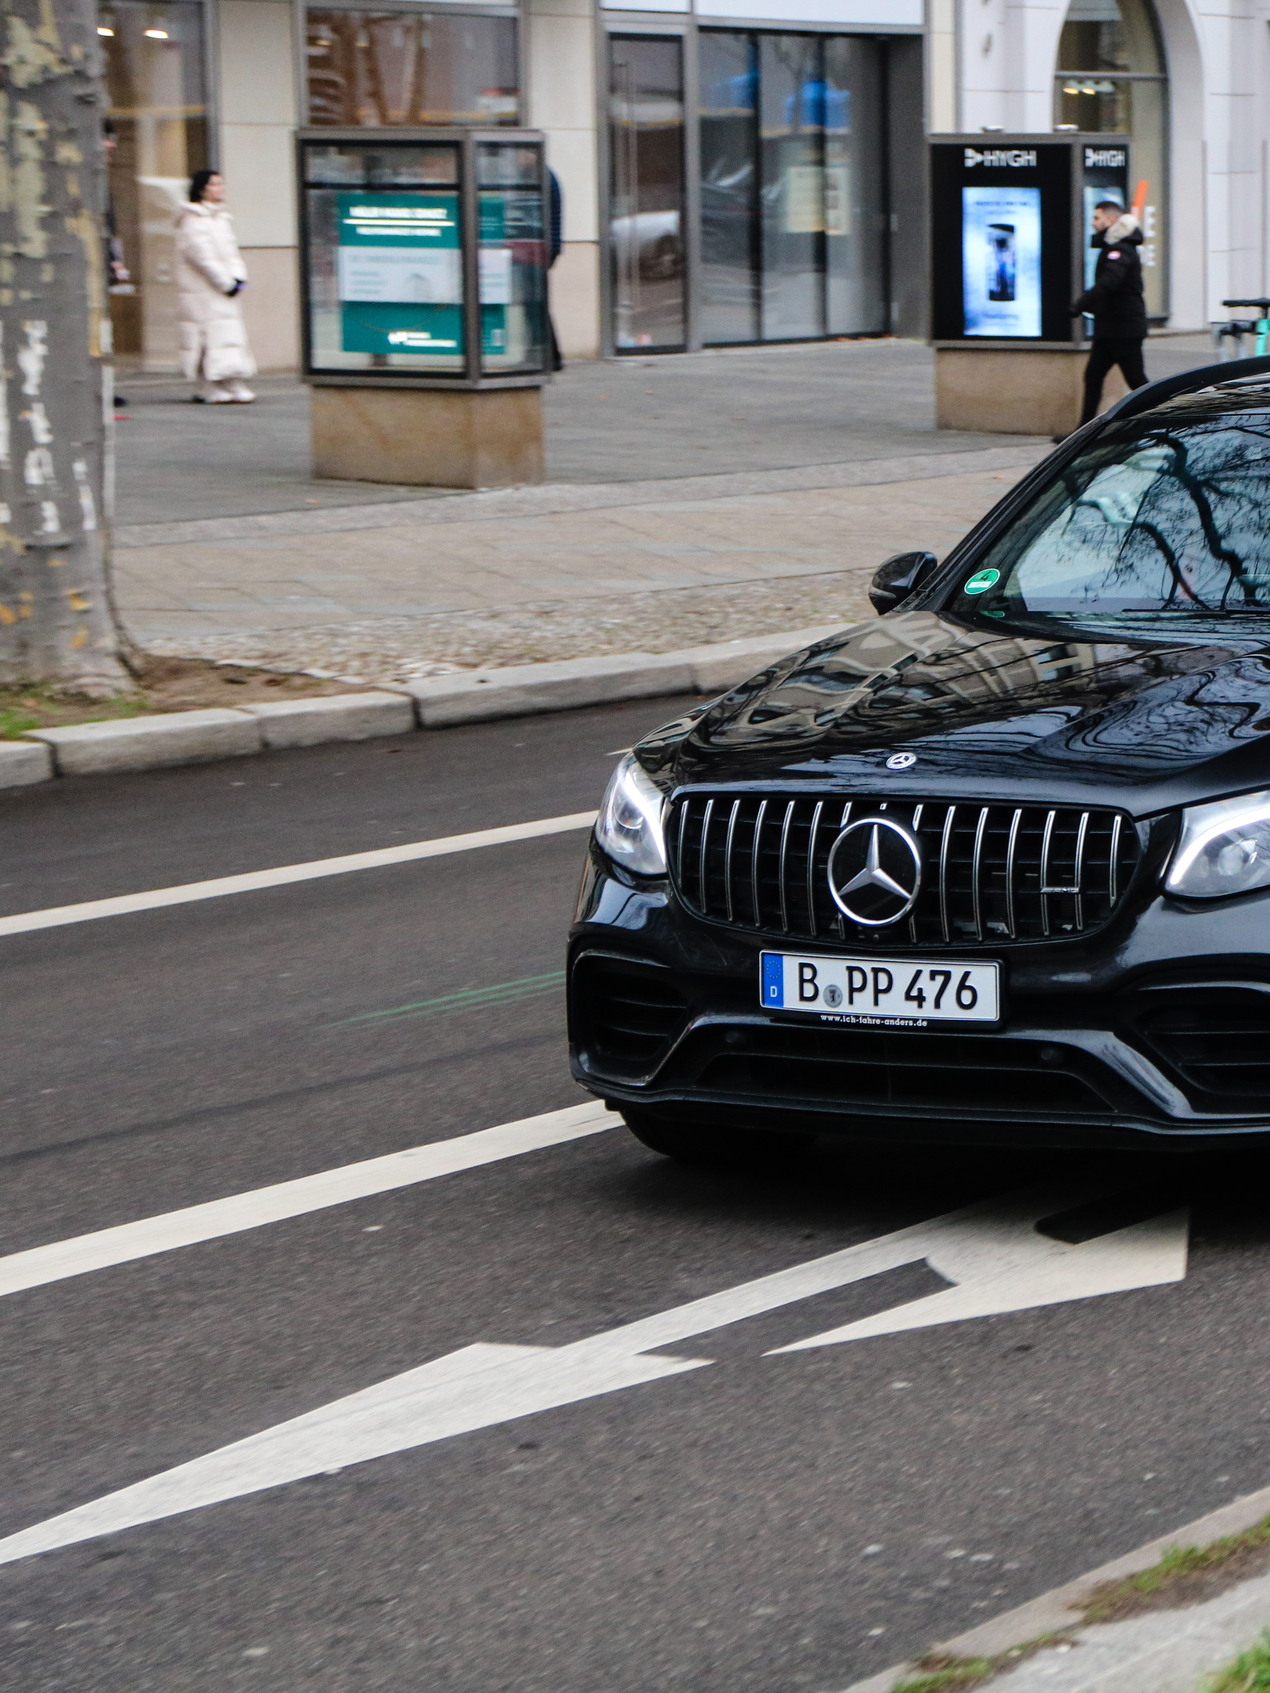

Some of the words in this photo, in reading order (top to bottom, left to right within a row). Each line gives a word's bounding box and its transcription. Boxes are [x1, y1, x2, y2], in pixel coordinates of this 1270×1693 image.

[983, 150, 1037, 167] HYGH
[769, 985, 778, 998] D
[798, 961, 819, 1003] B
[845, 964, 894, 1007] PP
[904, 968, 979, 1010] 476
[820, 1014, 928, 1027] www.ich-fahre-anders.de
